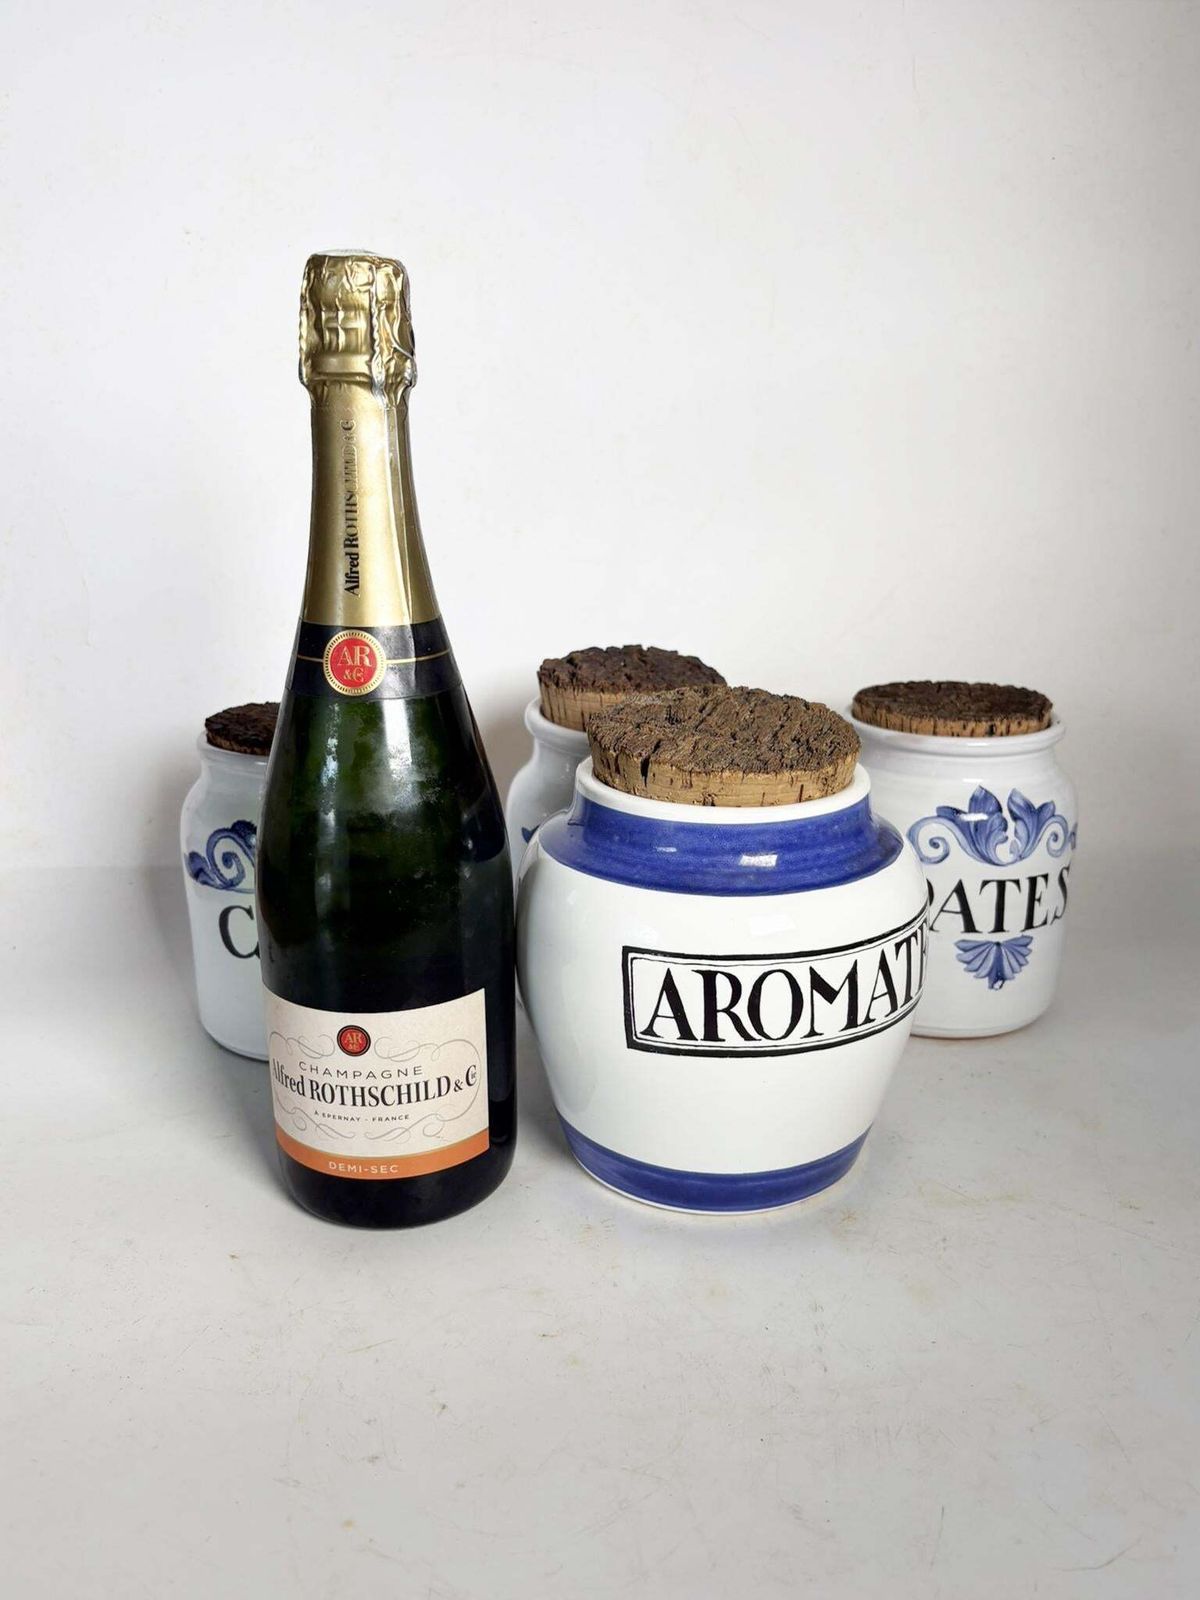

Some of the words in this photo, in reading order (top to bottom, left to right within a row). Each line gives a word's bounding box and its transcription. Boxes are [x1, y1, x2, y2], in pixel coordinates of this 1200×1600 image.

[343, 553, 360, 597] Alfred
[336, 645, 372, 668] AR
[298, 1061, 424, 1081] CHAMPAGNE
[271, 1058, 306, 1098] Alfred
[308, 1075, 451, 1108] ROTHSCHILD
[453, 1079, 464, 1093] &
[372, 1114, 410, 1122] FRANCE
[328, 1161, 400, 1174] DEMI-SEC
